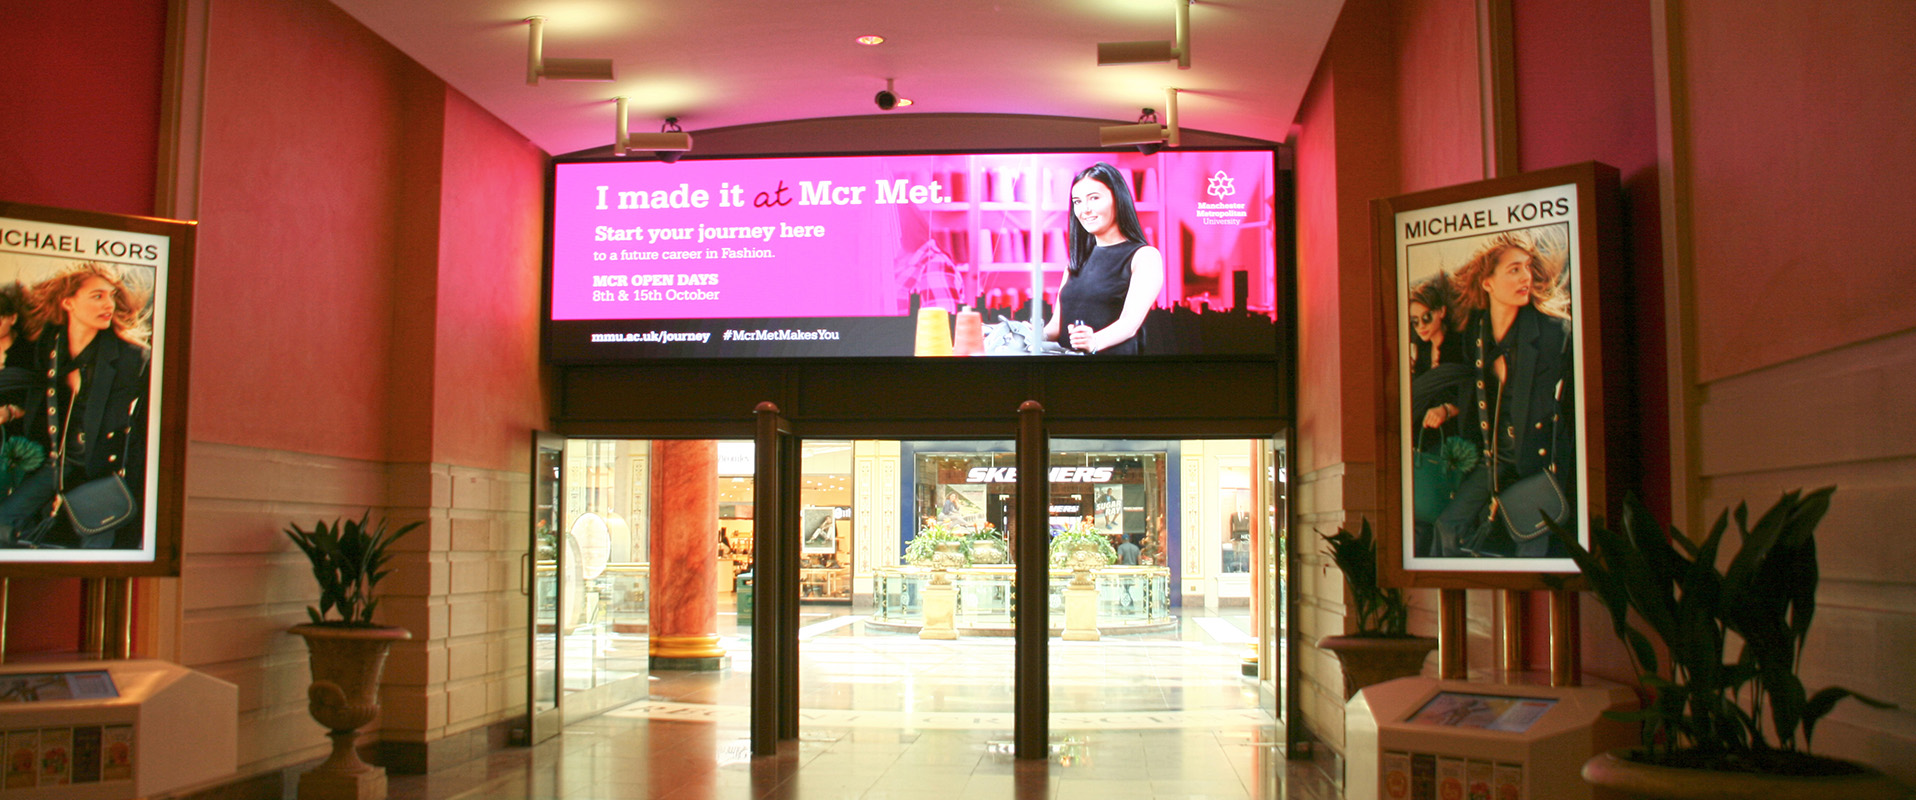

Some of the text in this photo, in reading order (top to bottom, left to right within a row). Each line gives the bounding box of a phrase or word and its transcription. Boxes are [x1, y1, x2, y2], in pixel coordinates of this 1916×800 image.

[595, 179, 952, 210] I made it at Mcr Met.
[1196, 210, 1247, 218] Metropolitan
[1404, 198, 1569, 239] MICHAEL KORS
[594, 222, 826, 244] Start your journey here
[96, 239, 158, 260] KORS
[593, 247, 776, 261] to a future career in Fashion.
[592, 273, 719, 287] MCR OPEN DAYS
[592, 288, 721, 302] 8th & 15th October
[591, 329, 840, 344] mmu.ac.uk/journey #McrMetMakesYou
[966, 466, 1114, 483] SKEHERS
